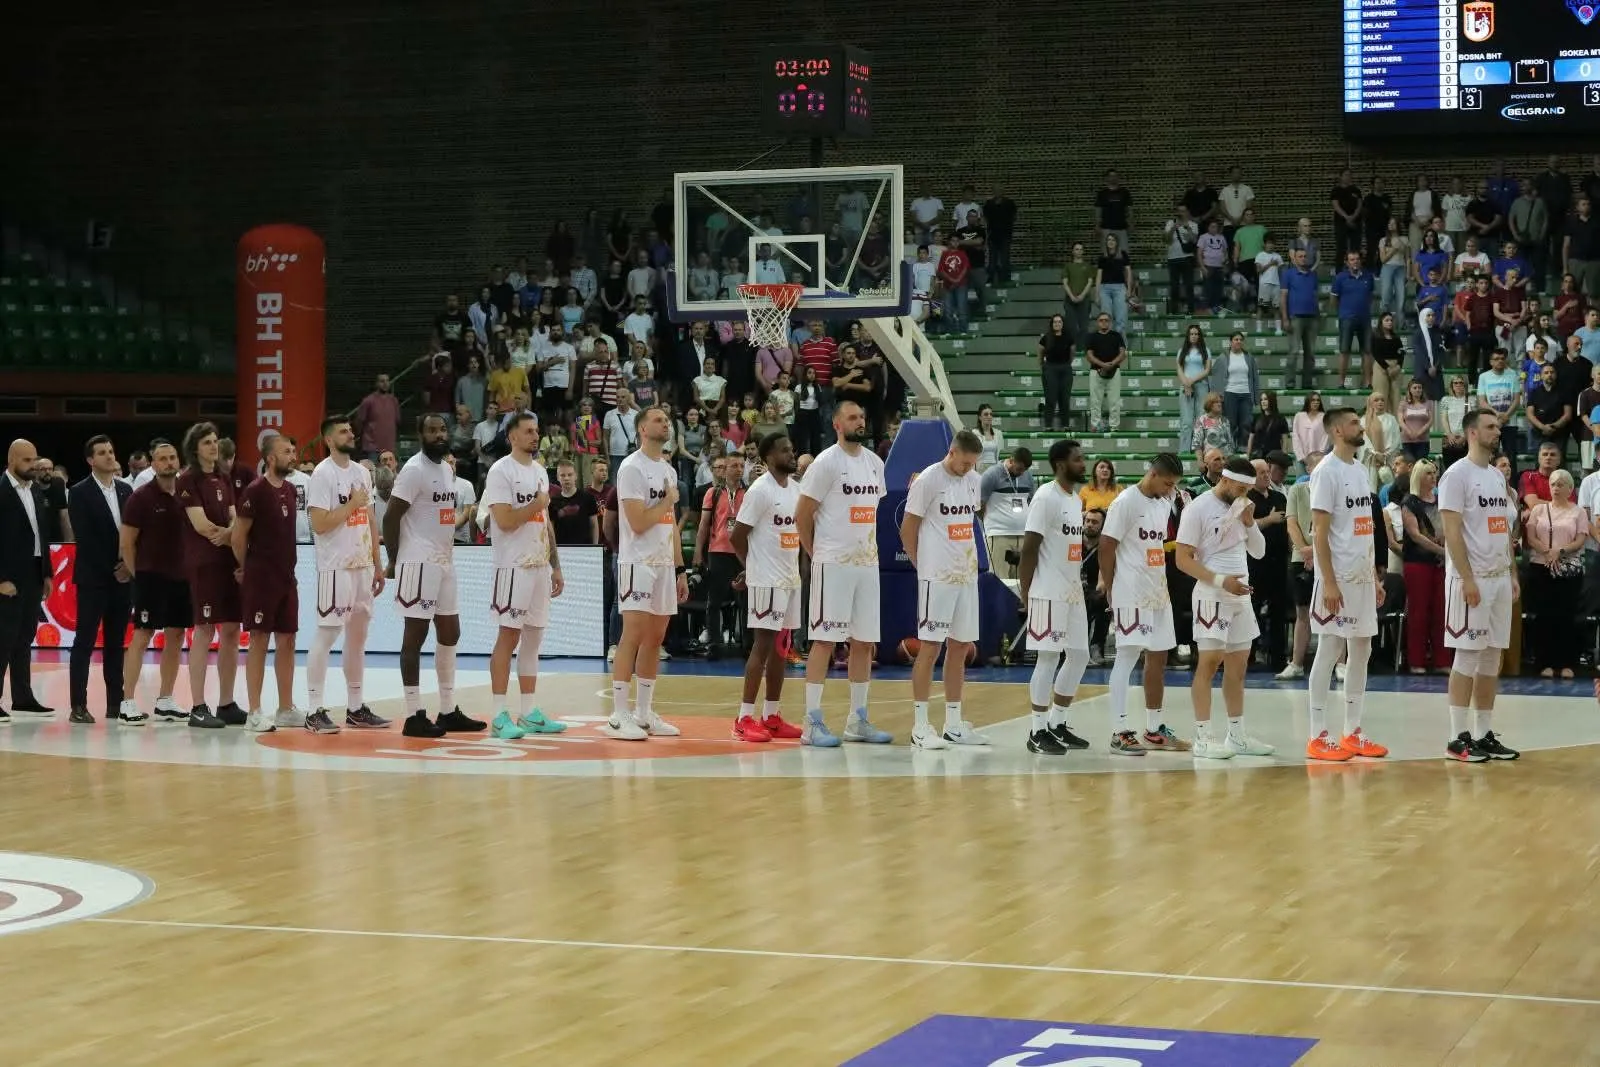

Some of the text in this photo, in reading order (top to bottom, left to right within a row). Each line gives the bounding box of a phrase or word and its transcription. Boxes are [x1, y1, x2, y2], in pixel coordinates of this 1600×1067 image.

[775, 59, 830, 77] 03:00
[1474, 66, 1486, 80] 0
[1529, 67, 1536, 78] 1
[1580, 62, 1591, 77] 0
[1466, 95, 1475, 107] 3
[1591, 91, 1600, 103] 3
[1507, 106, 1566, 116] BELGRAND
[256, 292, 283, 340] BH
